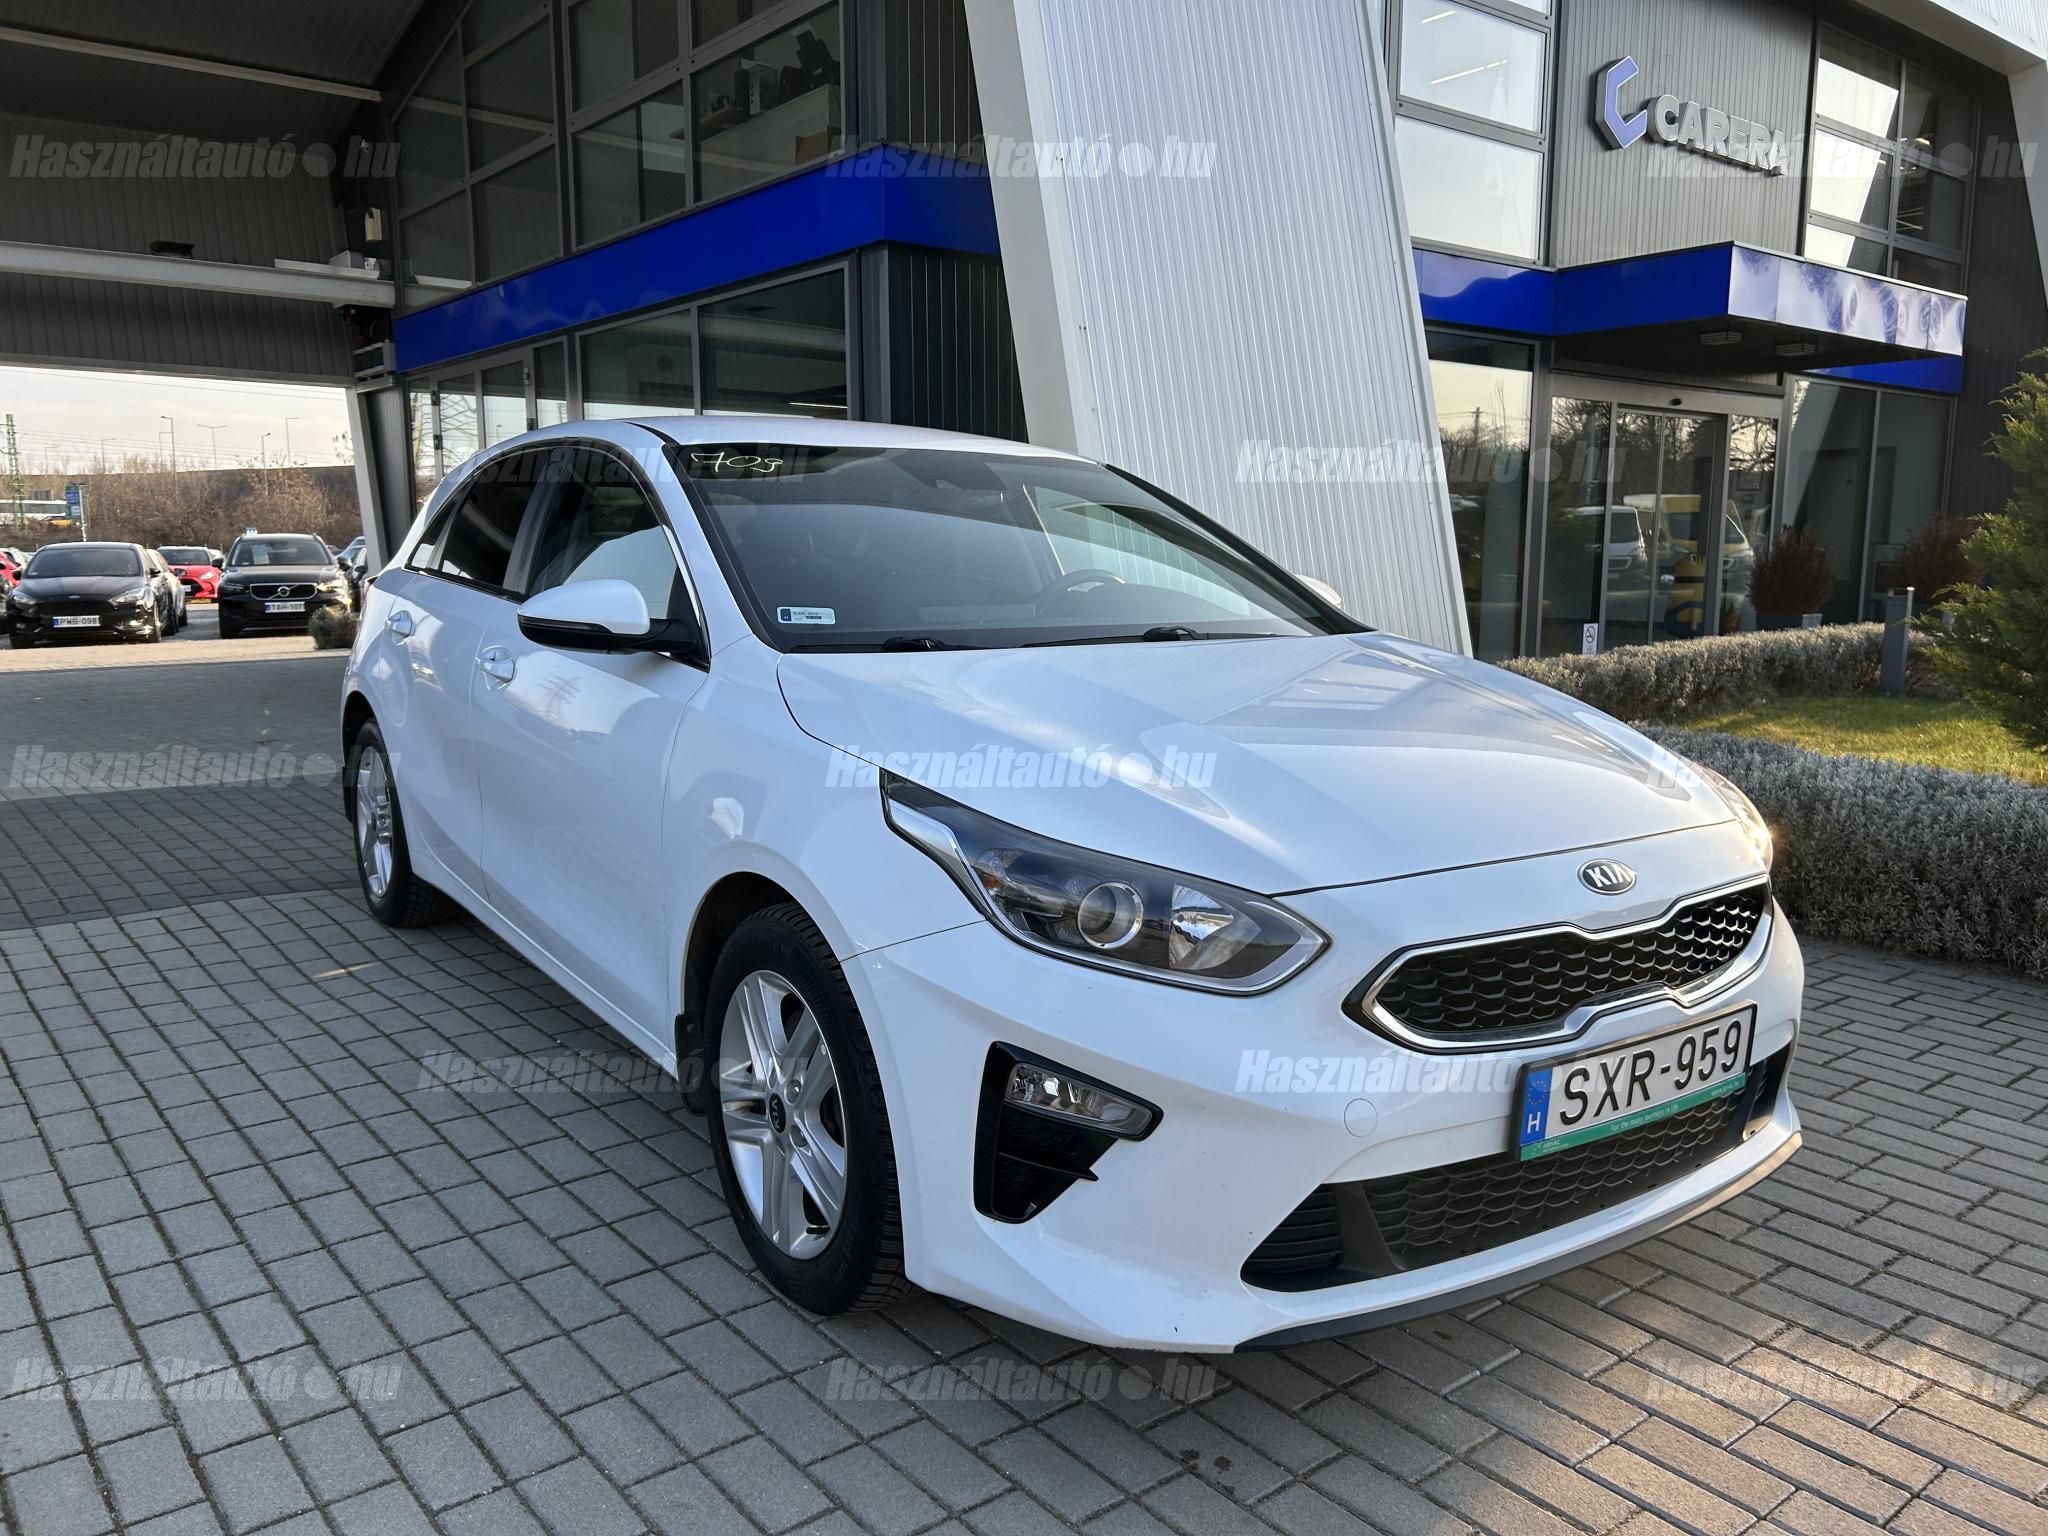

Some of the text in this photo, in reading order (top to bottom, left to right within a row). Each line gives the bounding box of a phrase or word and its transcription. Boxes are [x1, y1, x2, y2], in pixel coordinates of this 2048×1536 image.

[1650, 94, 1786, 172] CARERA
[1585, 864, 1632, 887] KIA
[1560, 1018, 1742, 1125] SXR-959
[1526, 1111, 1541, 1134] H
